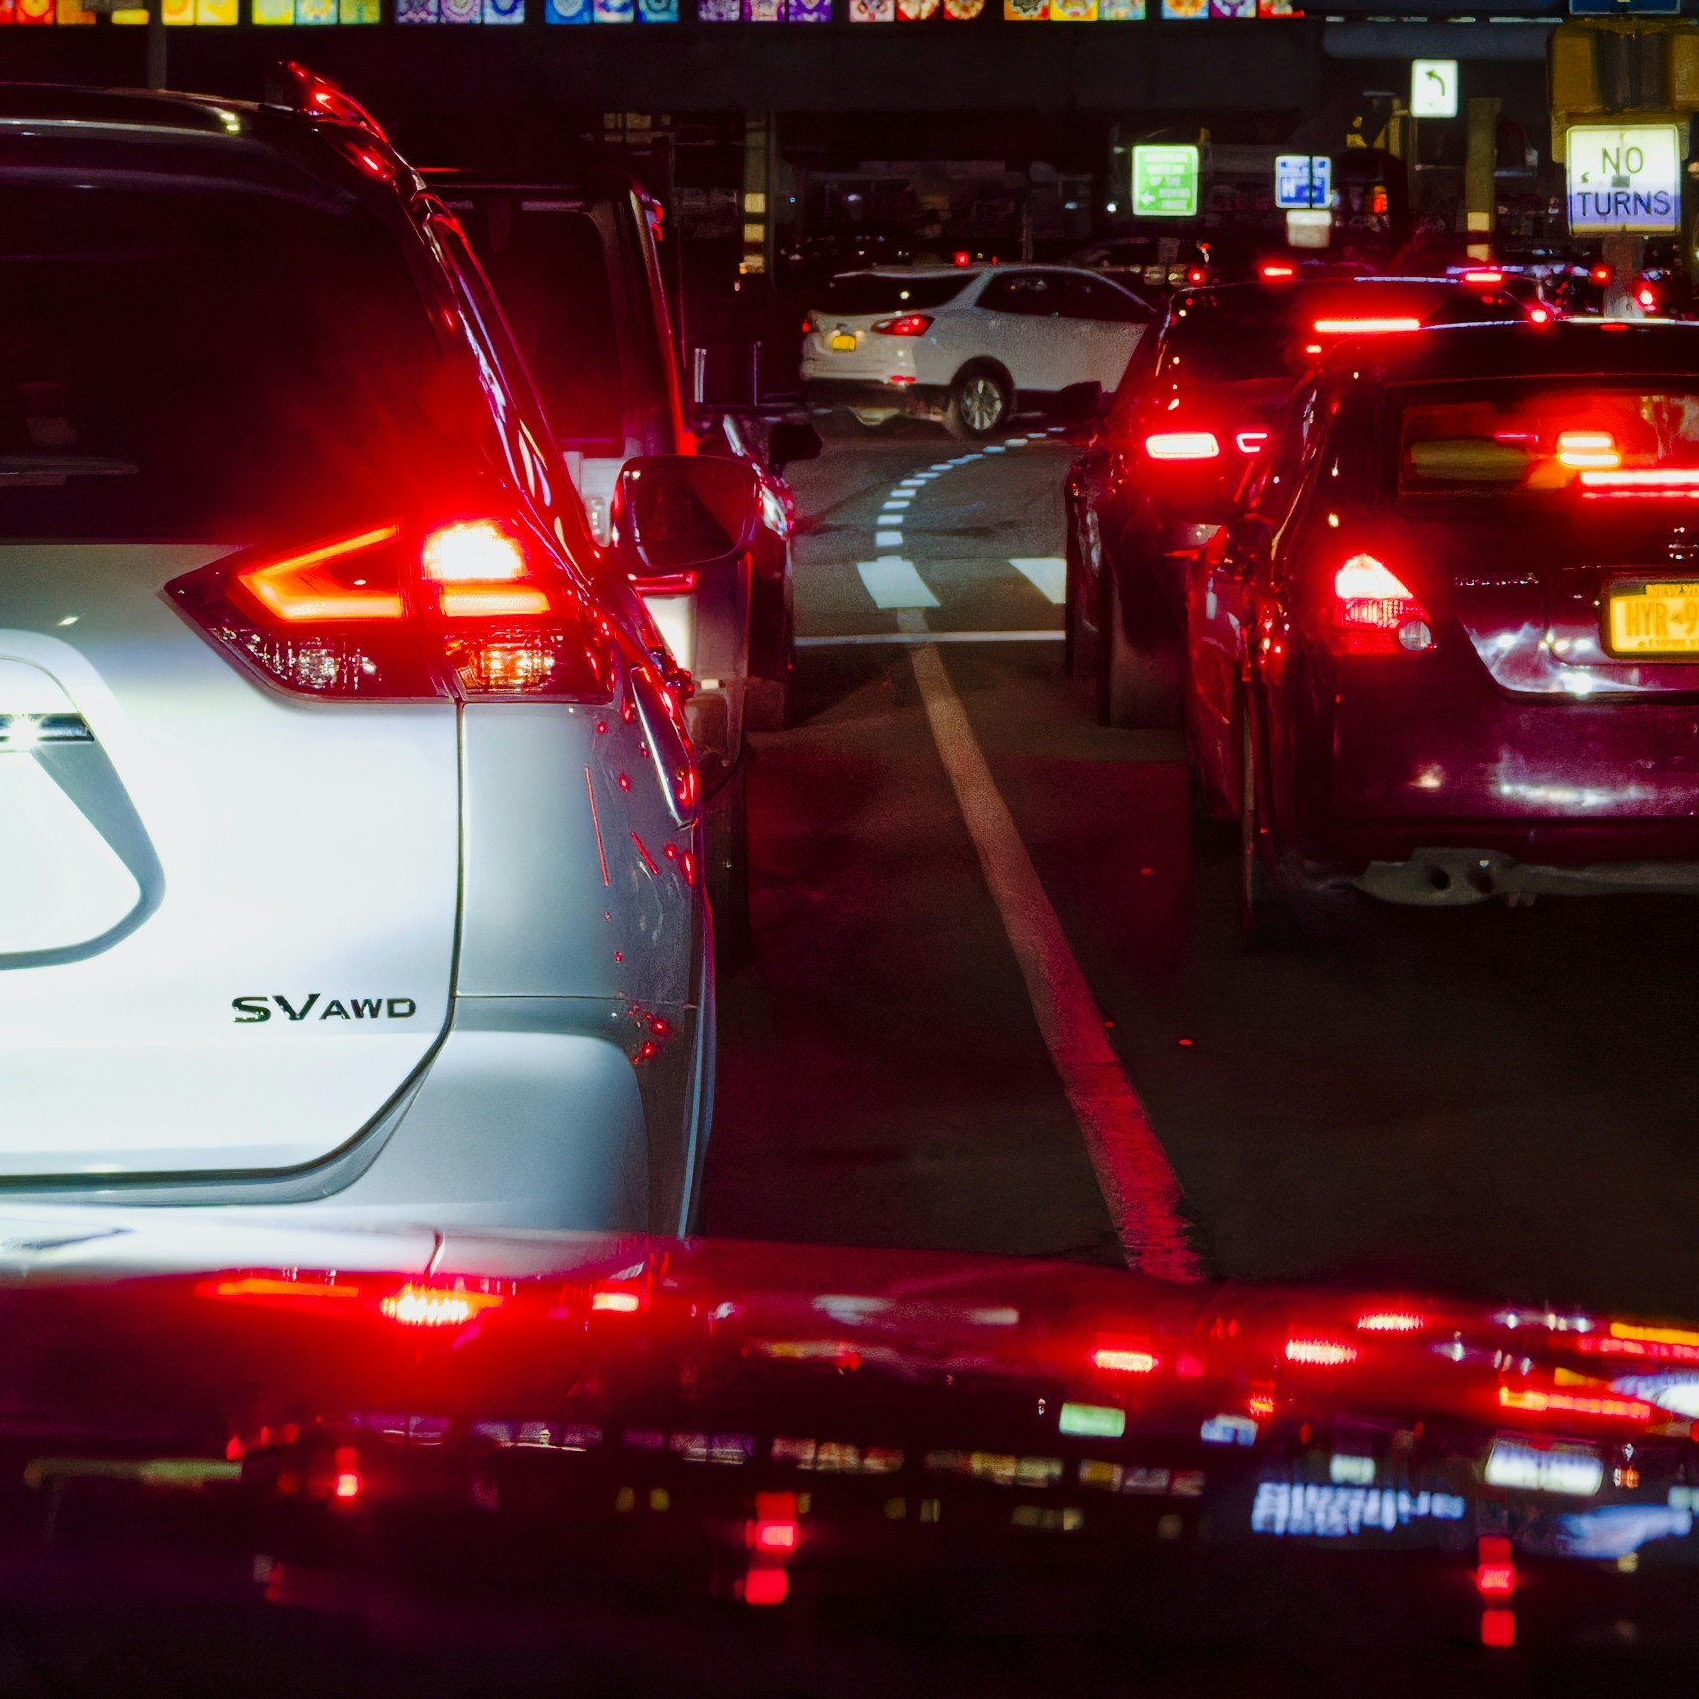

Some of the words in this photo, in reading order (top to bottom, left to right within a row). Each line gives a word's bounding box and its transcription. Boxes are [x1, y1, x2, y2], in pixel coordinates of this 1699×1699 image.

[1601, 147, 1645, 175] NO
[1577, 190, 1672, 217] TURNS
[1625, 601, 1669, 637] HYR
